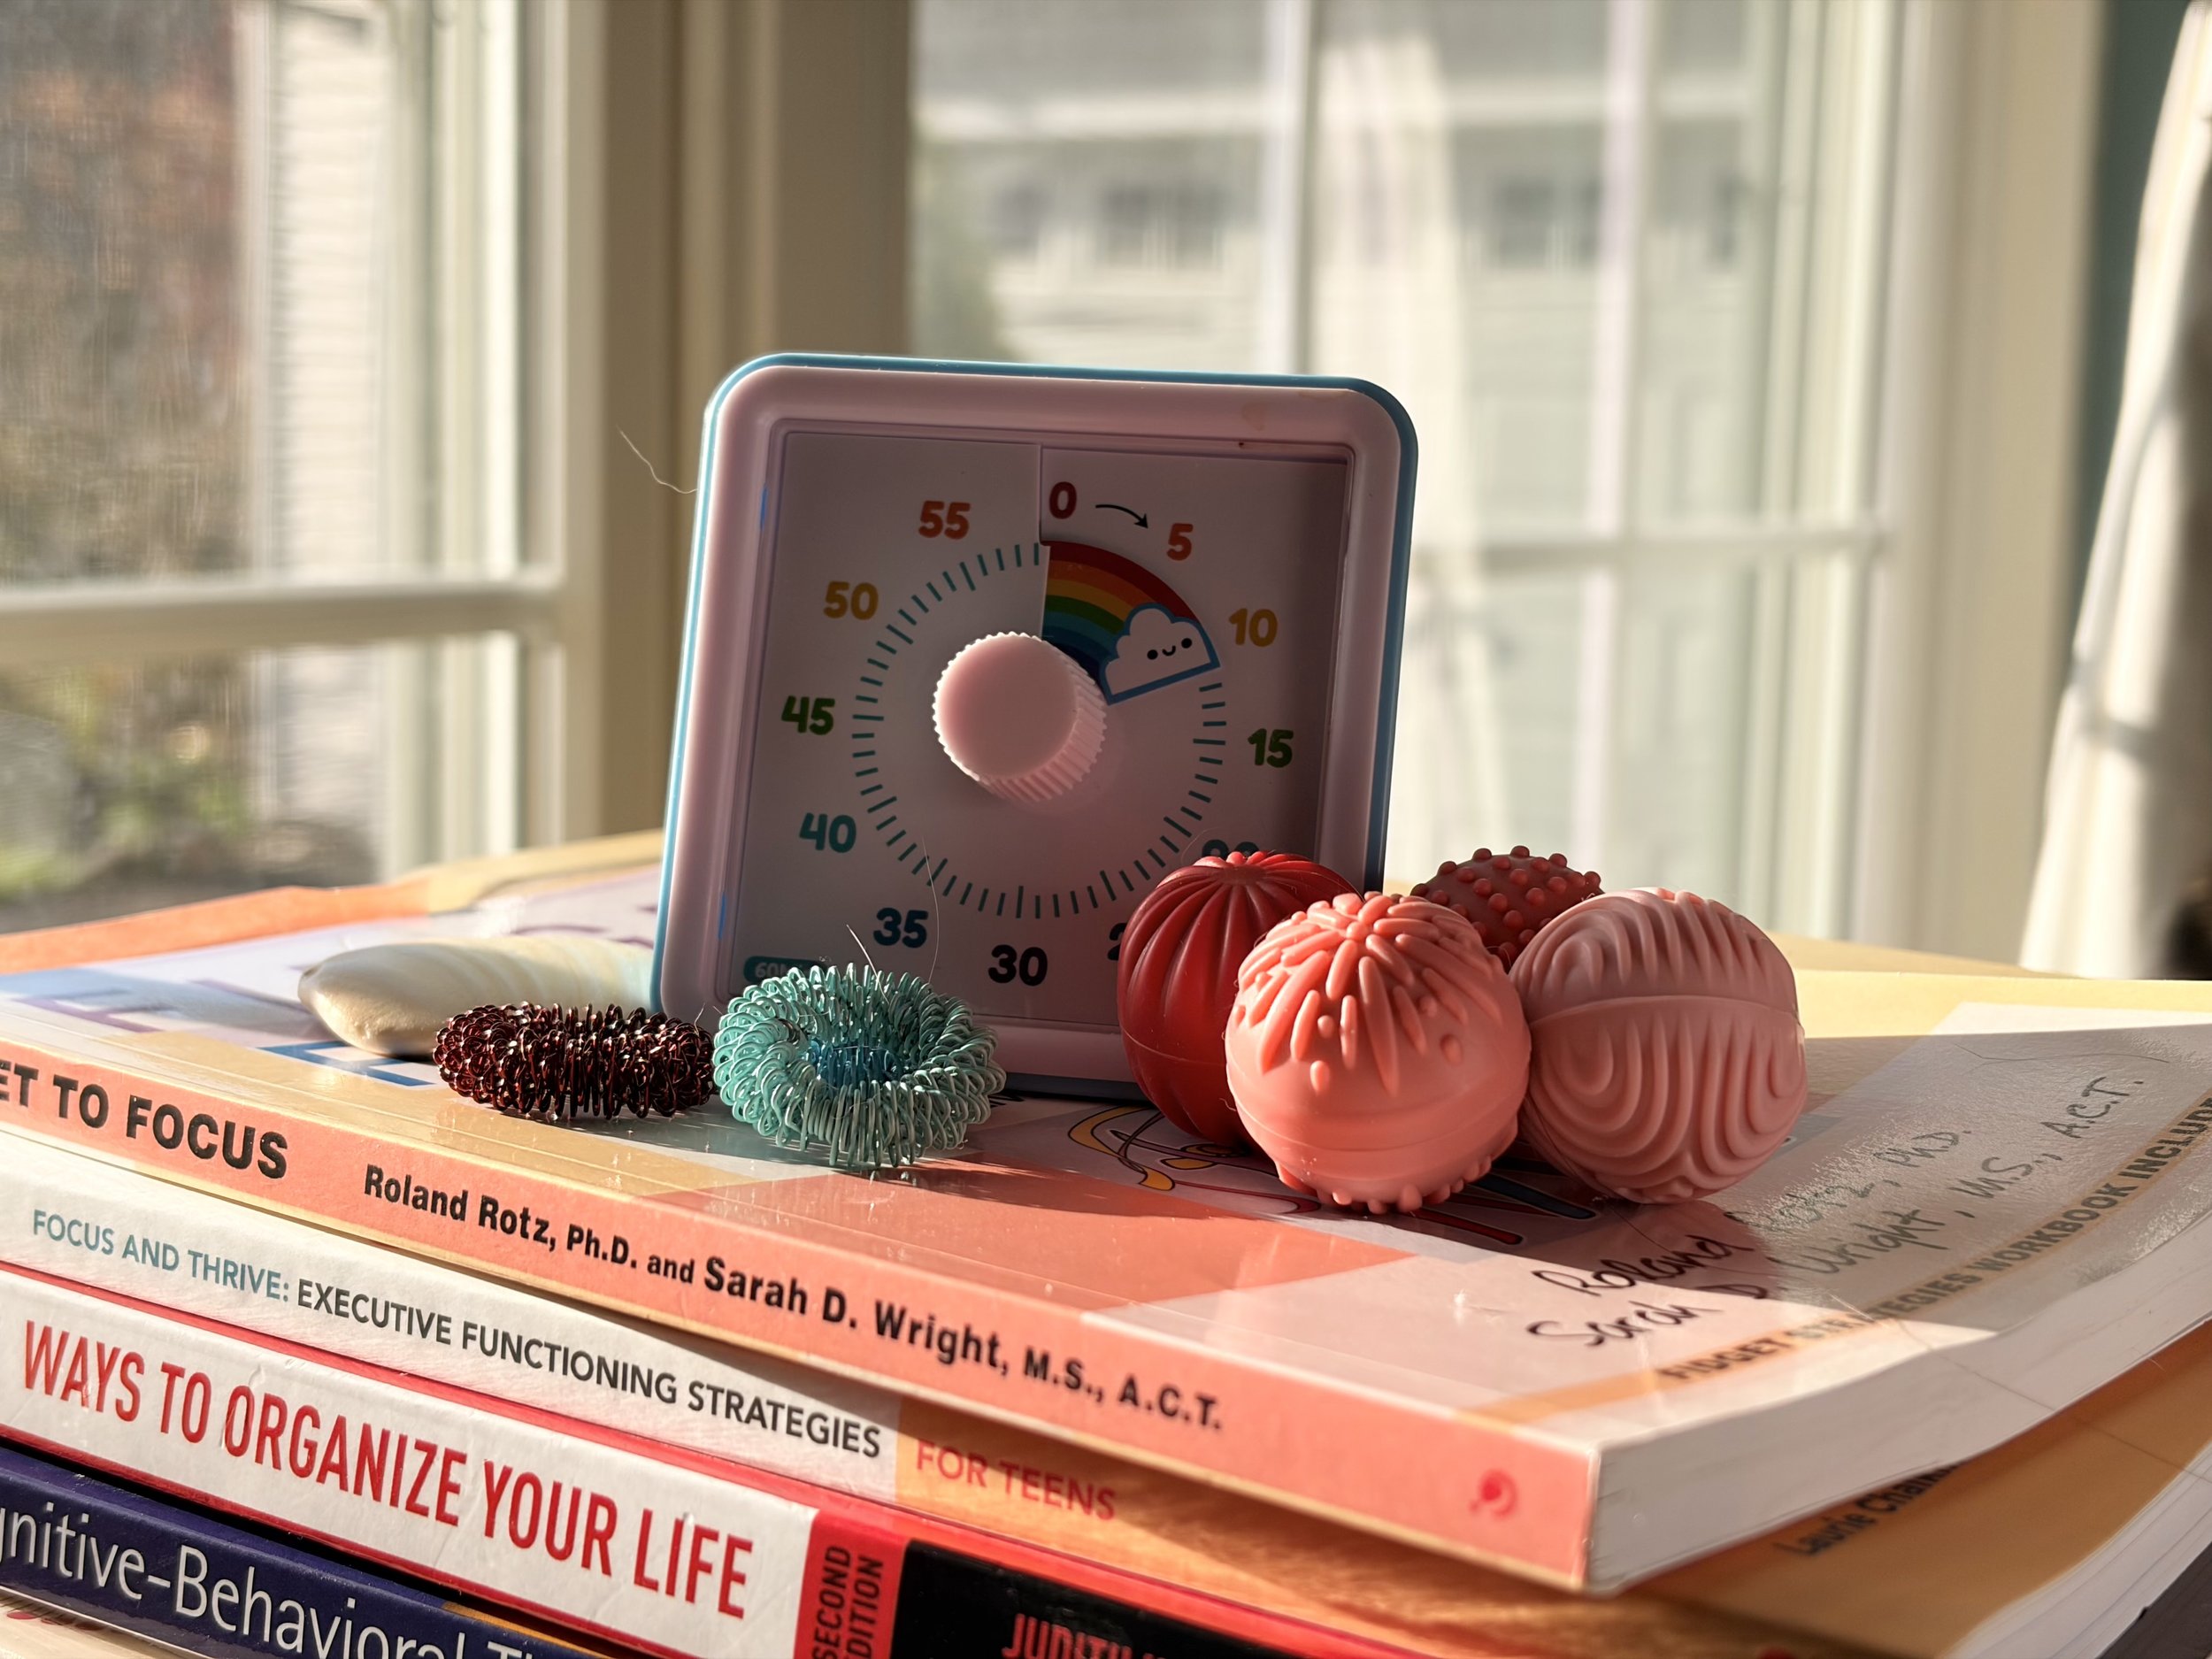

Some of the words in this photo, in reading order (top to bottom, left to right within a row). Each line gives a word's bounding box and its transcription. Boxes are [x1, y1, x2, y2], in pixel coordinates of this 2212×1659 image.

[918, 500, 972, 540] 55
[1049, 481, 1078, 520] 0
[1166, 523, 1194, 561] 5
[823, 580, 879, 620] 50
[1227, 608, 1278, 648] 10
[780, 696, 835, 736] 45
[1247, 728, 1294, 768] 15
[798, 813, 857, 854] 40
[872, 908, 929, 949] 35
[987, 944, 1048, 986] 30
[53, 1074, 110, 1129] TO
[127, 1094, 288, 1179] FOCUS
[364, 1164, 469, 1222] Roland
[478, 1194, 557, 1253] Rotz,
[566, 1224, 638, 1269] Ph.D.
[647, 1253, 695, 1284] and
[703, 1256, 809, 1316] Sarah
[821, 1286, 858, 1330] D.
[873, 1300, 1010, 1377] Wright,
[1024, 1347, 1104, 1403] M.S.,
[1118, 1373, 1222, 1431] A.C.T.
[1531, 1234, 1756, 1297] Roland
[1655, 1336, 1795, 1380] FIDGET
[1965, 1182, 2139, 1274] WORKBOOK
[1526, 1300, 1724, 1347] Sarah
[33, 1209, 116, 1256] FOCUS
[121, 1234, 180, 1271] AND
[188, 1249, 289, 1302] THRIVE:
[297, 1279, 452, 1346] EXECUTIVE
[462, 1321, 678, 1404] FUNCTIONING
[687, 1379, 882, 1458] STRATEGIES
[916, 1438, 987, 1488] FOR
[998, 1460, 1117, 1521] TEENS
[24, 1319, 145, 1422] WAYS
[160, 1361, 212, 1444] TO
[224, 1385, 468, 1527] ORGANIZE
[484, 1459, 618, 1578] YOUR
[633, 1508, 754, 1620] LIFE
[843, 1555, 884, 1659] DITION
